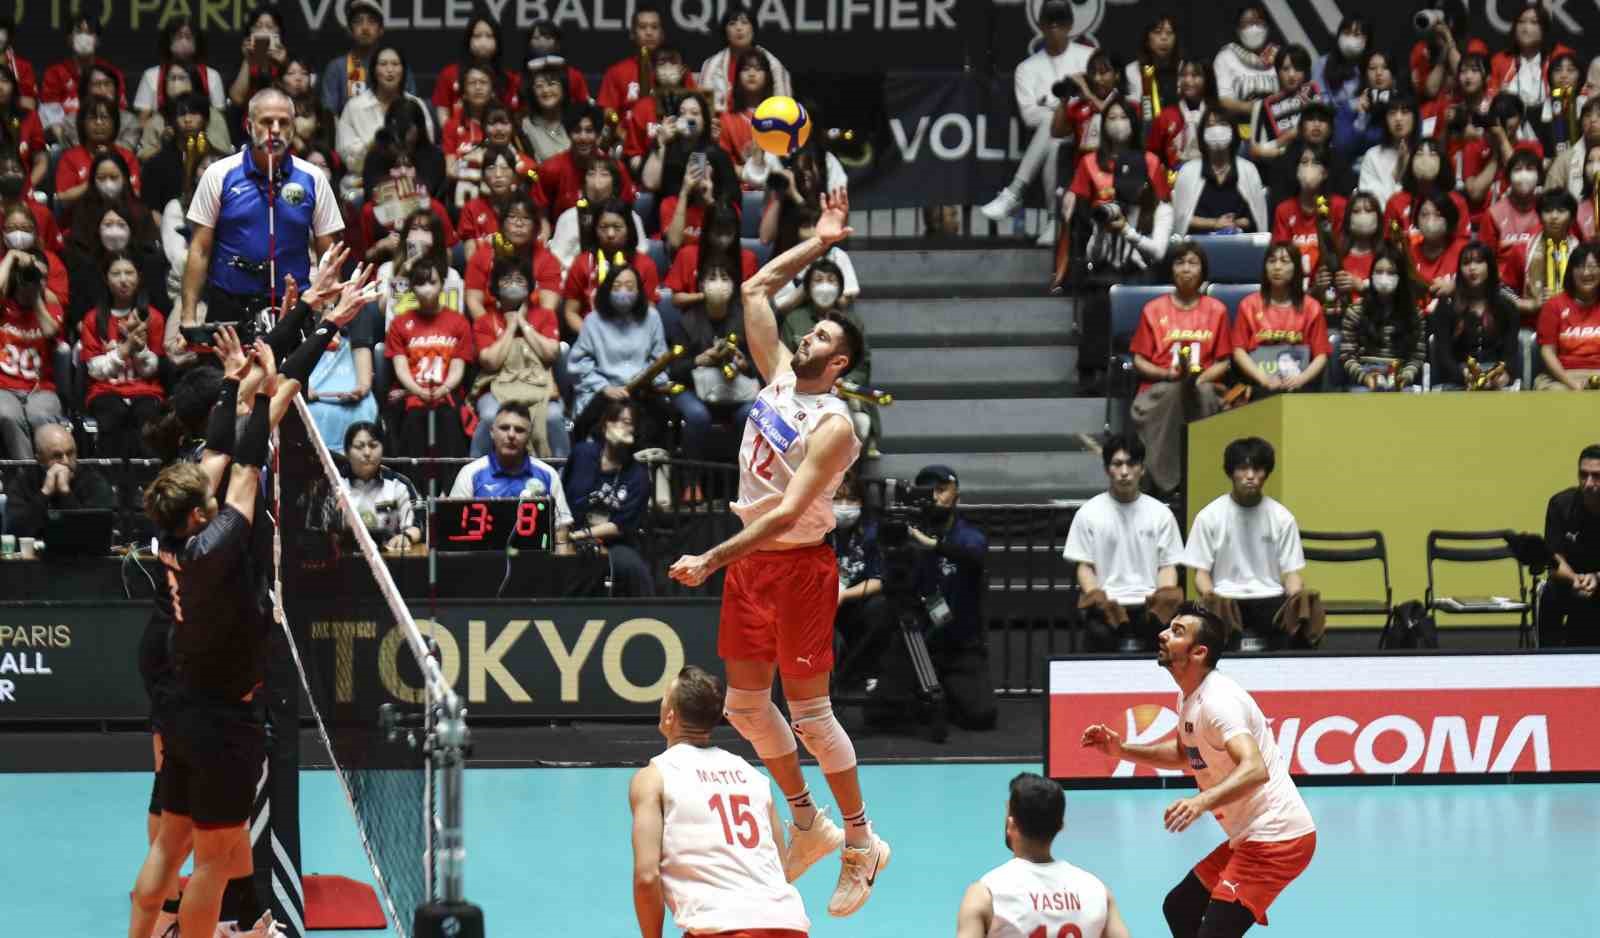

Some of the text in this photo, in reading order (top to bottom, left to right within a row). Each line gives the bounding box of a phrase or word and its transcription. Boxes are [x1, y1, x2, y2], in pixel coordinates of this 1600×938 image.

[130, 0, 258, 31] PARI
[1559, 325, 1600, 340] JAPA
[0, 624, 72, 648] PARIS
[311, 618, 685, 703] TOKYO
[695, 768, 748, 785] MATIC
[708, 792, 760, 849] 15
